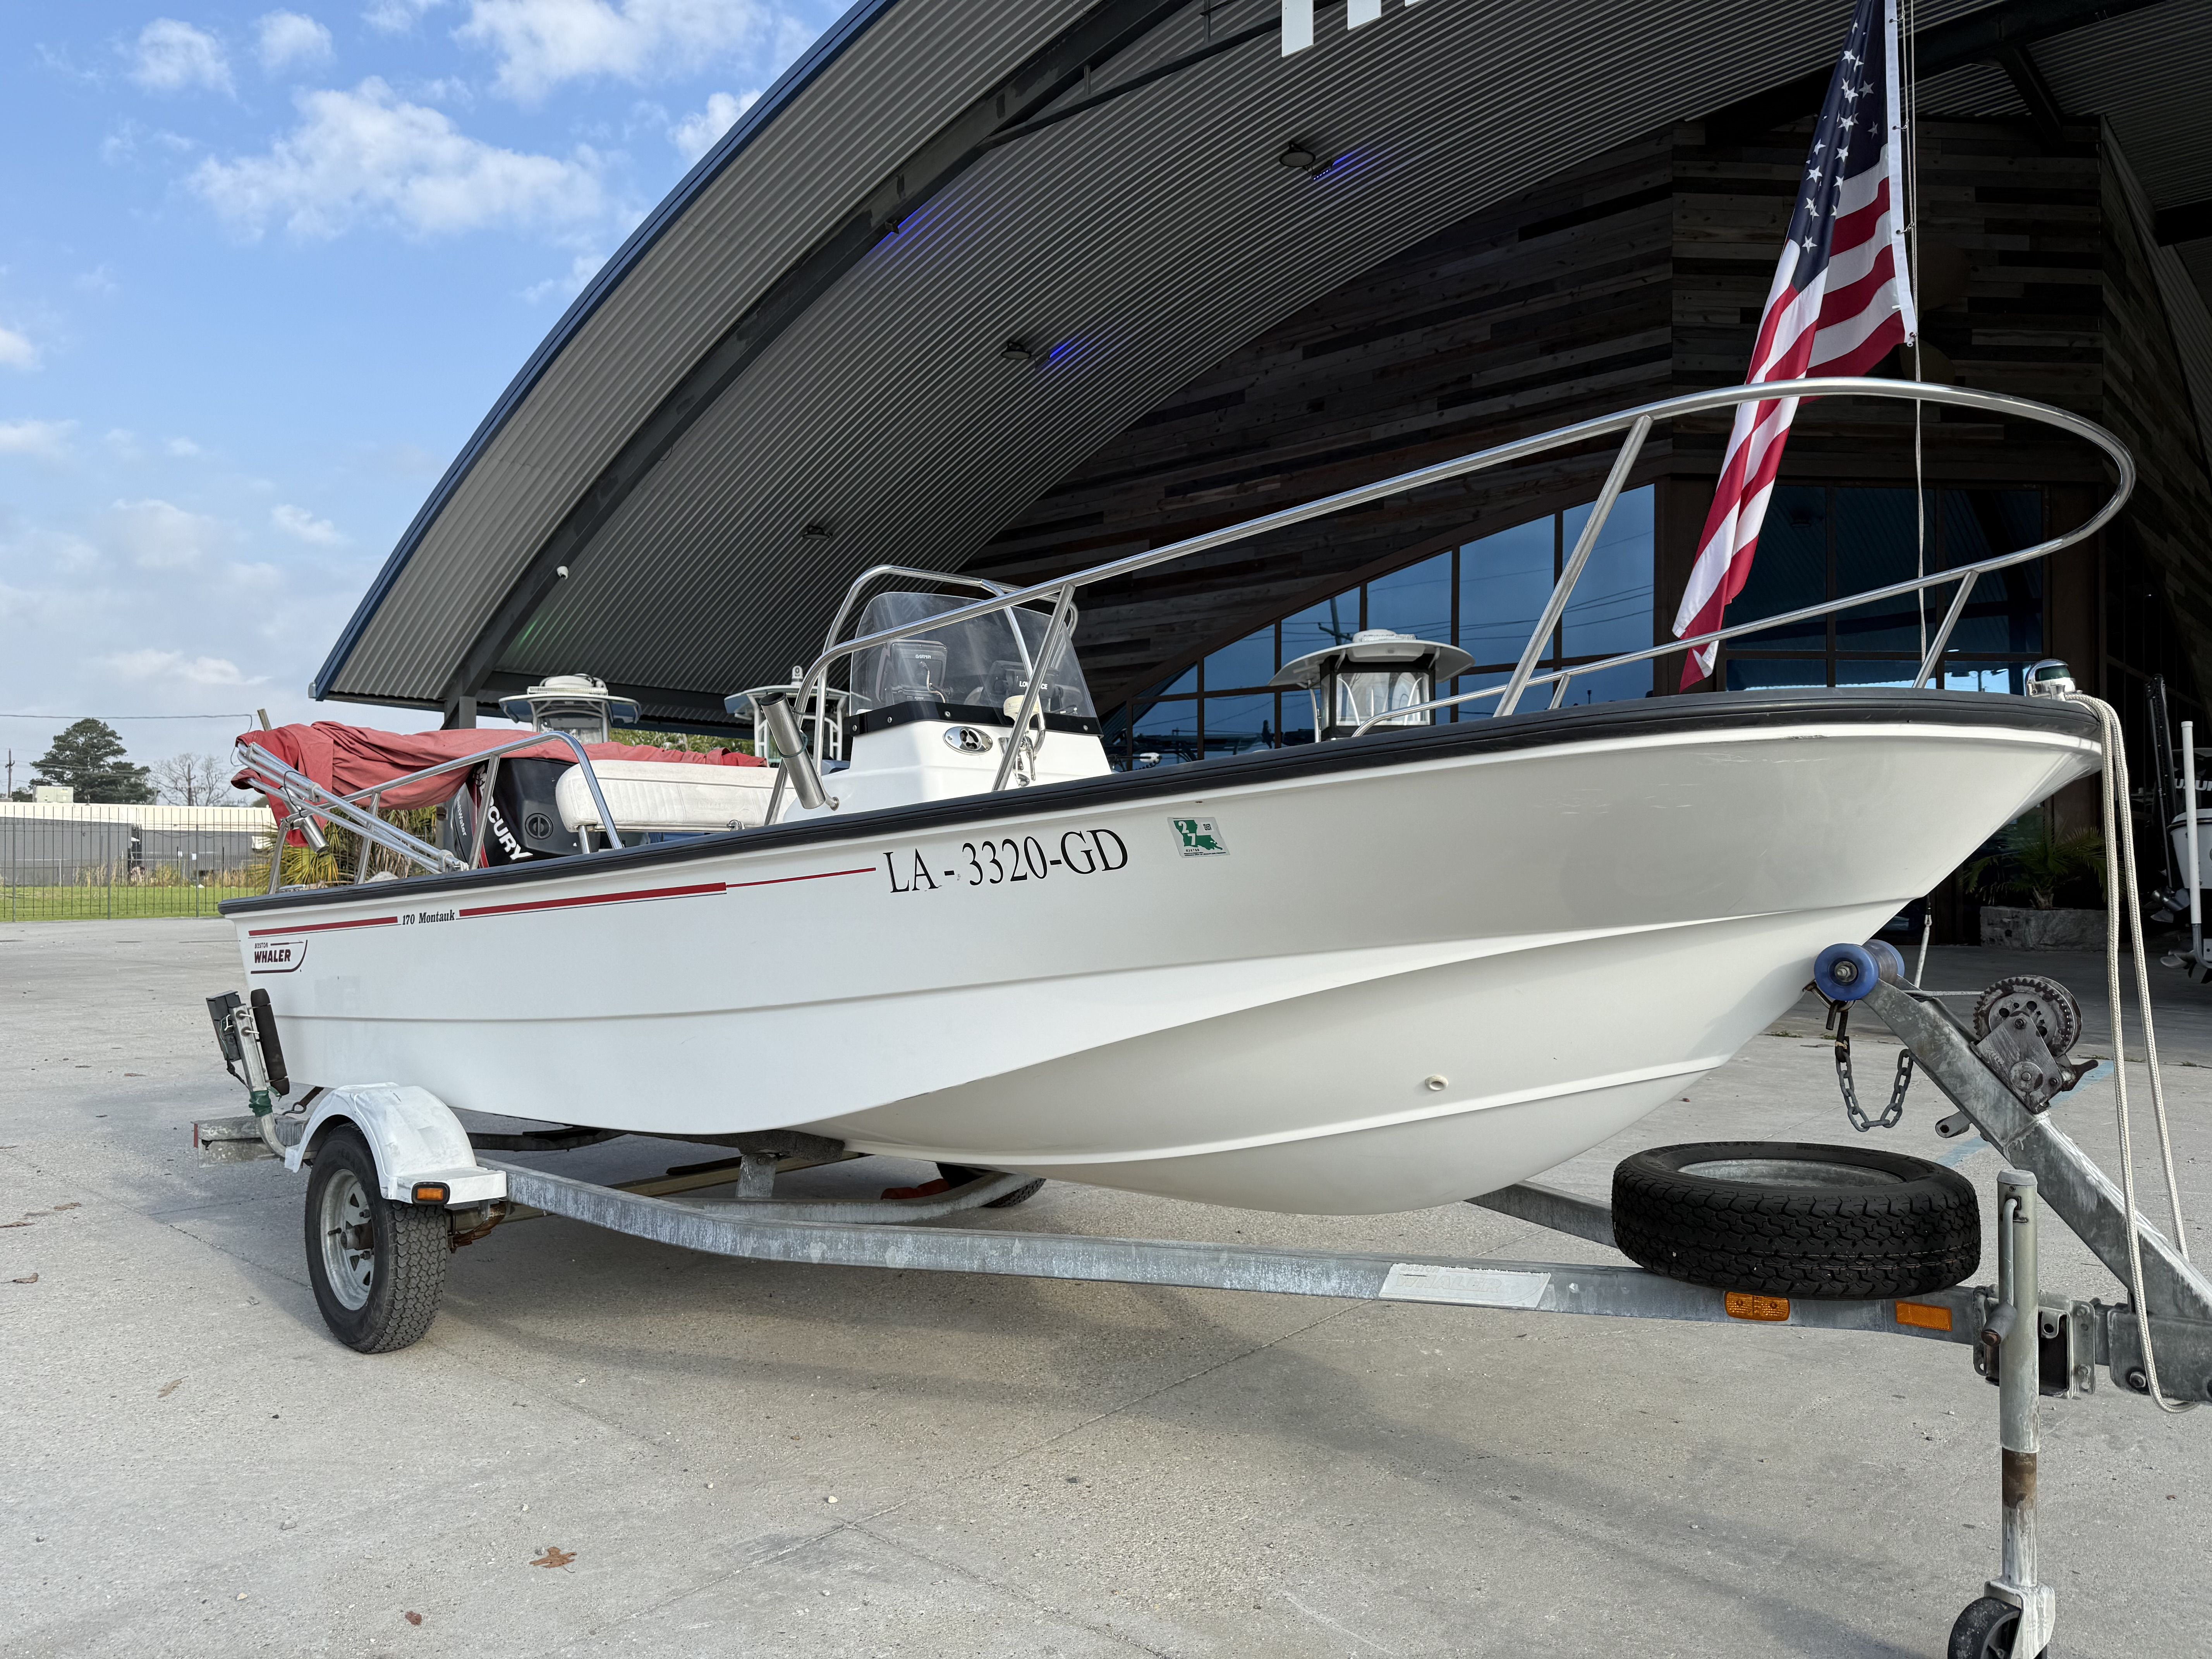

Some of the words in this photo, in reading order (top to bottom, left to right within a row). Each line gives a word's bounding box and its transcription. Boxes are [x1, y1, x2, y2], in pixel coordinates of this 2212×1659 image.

[402, 914, 415, 925] 170
[419, 909, 455, 924] Montauk
[254, 949, 291, 963] WHALER
[1400, 1264, 1440, 1273] BOSTON
[1395, 1274, 1502, 1293] WHALER
